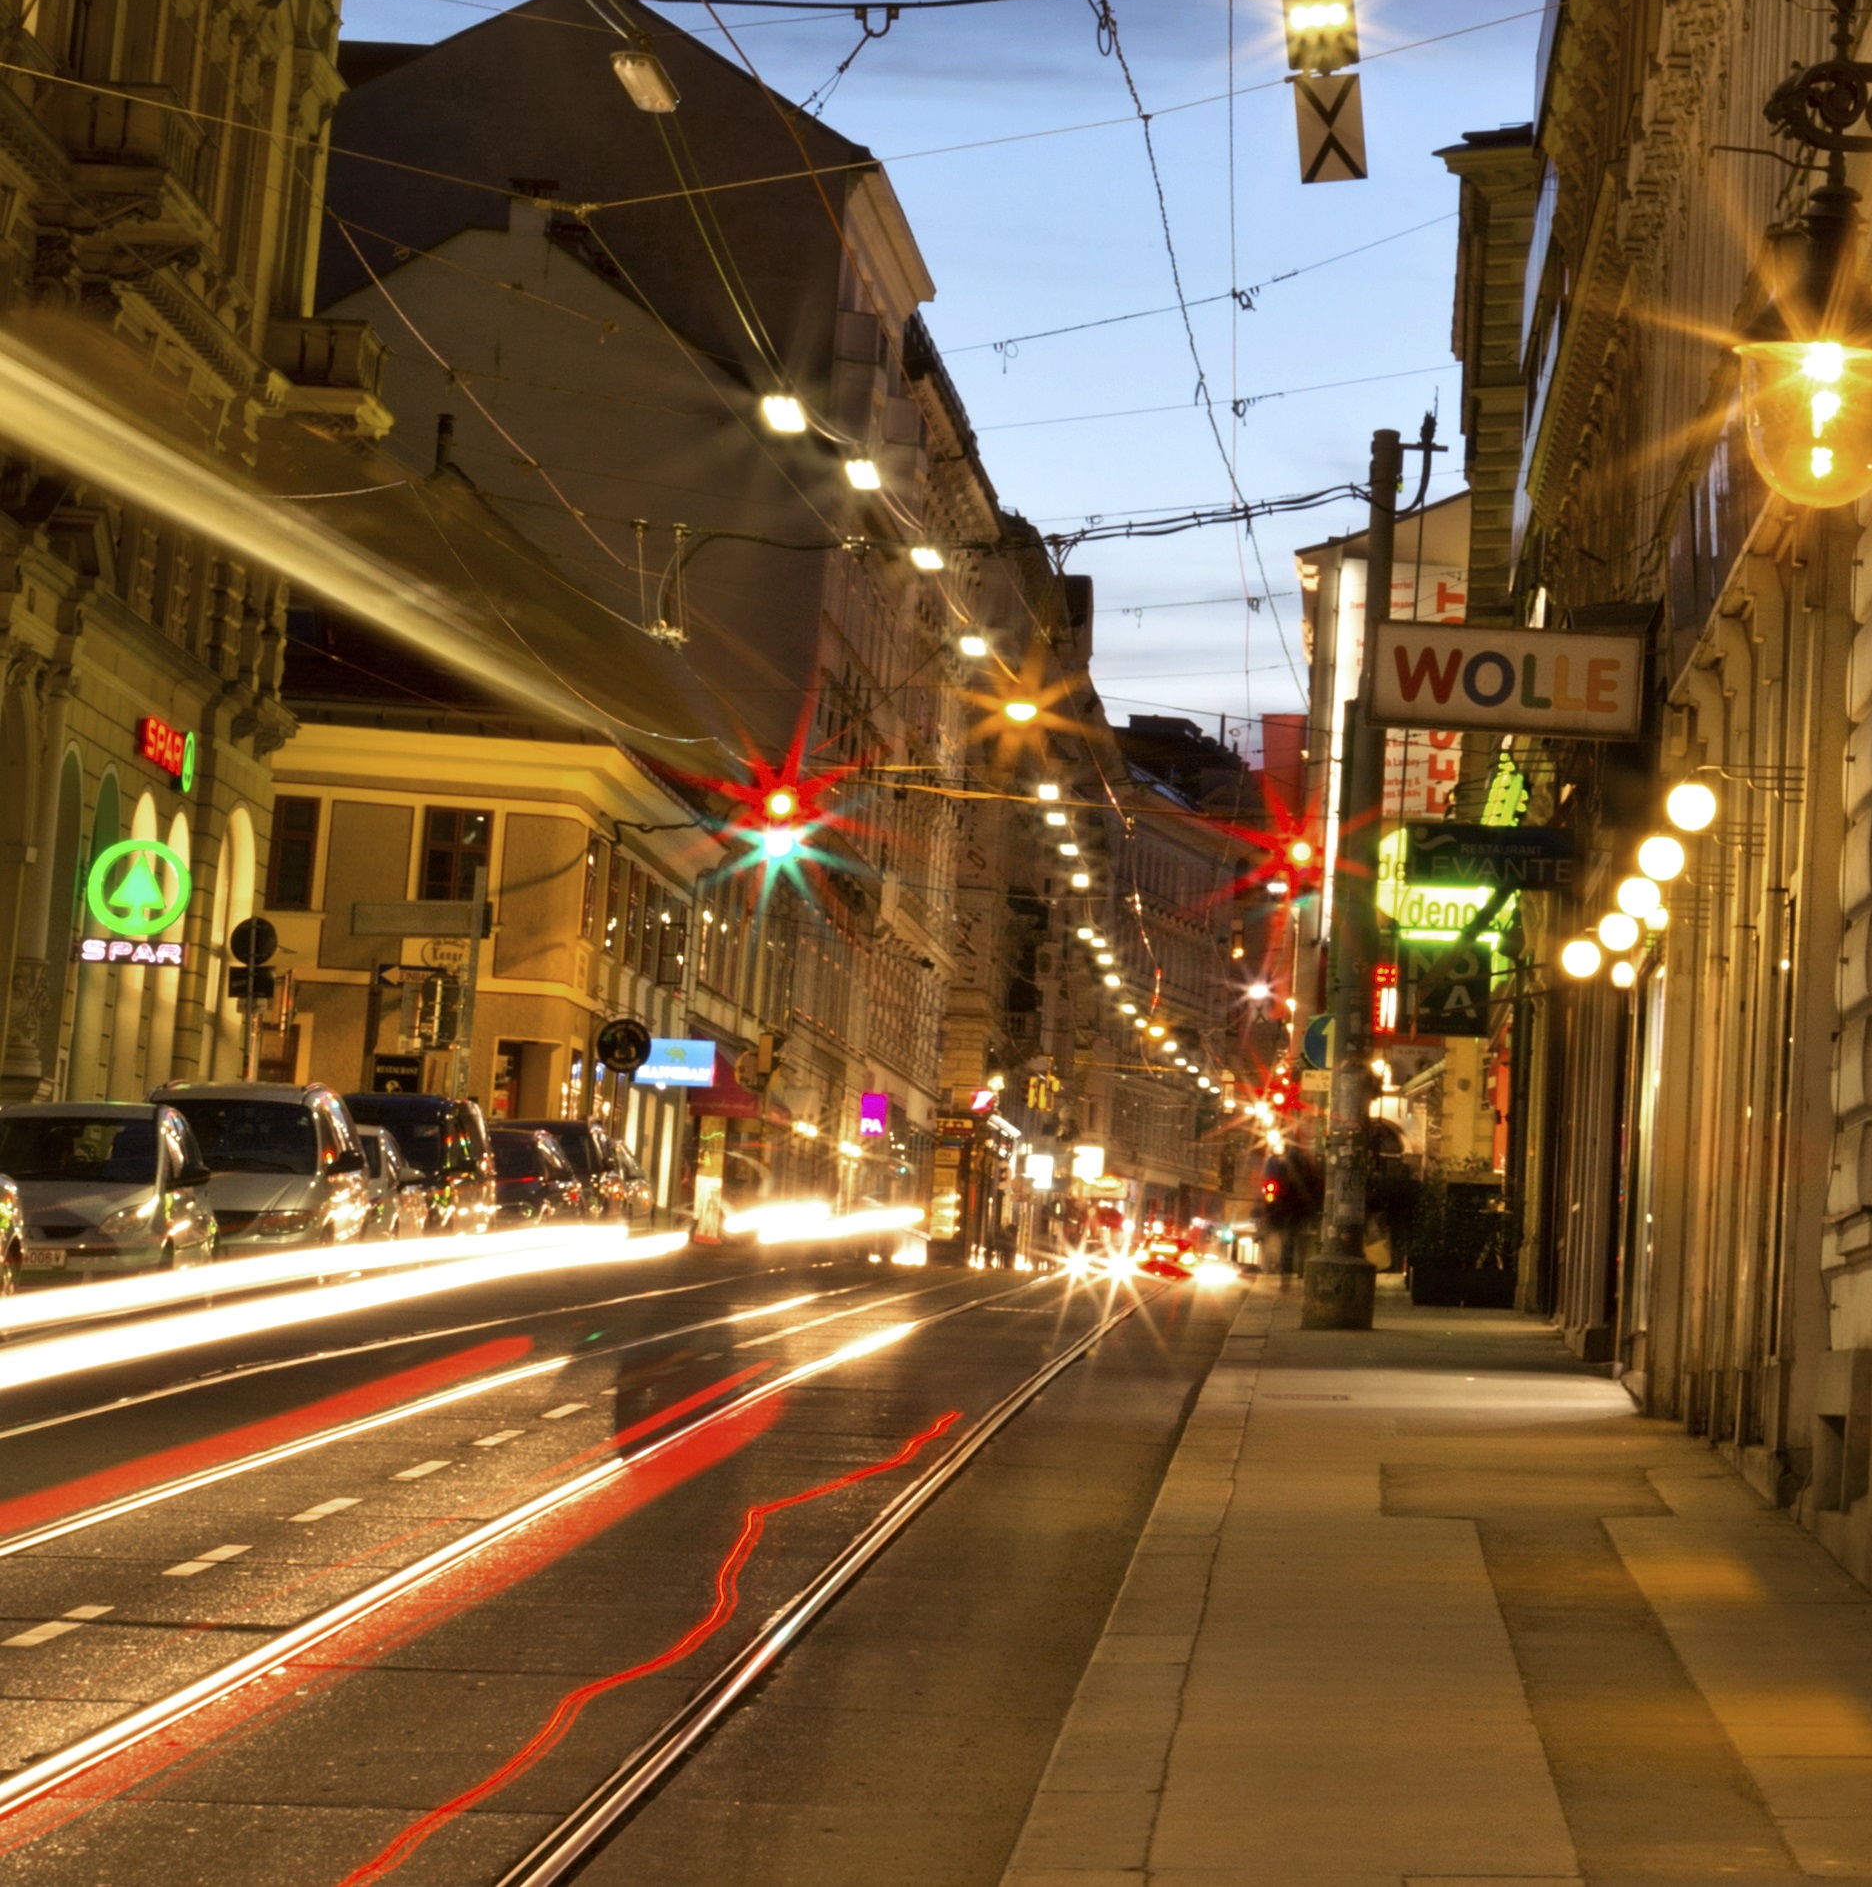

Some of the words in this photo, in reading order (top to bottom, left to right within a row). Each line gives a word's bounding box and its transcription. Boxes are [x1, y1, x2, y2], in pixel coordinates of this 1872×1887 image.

[1394, 645, 1621, 713] WOLLE
[146, 717, 184, 777] SPAR
[1460, 843, 1543, 856] RESTAURANT
[1410, 856, 1573, 883] LEVANTE
[81, 939, 182, 965] SPAR
